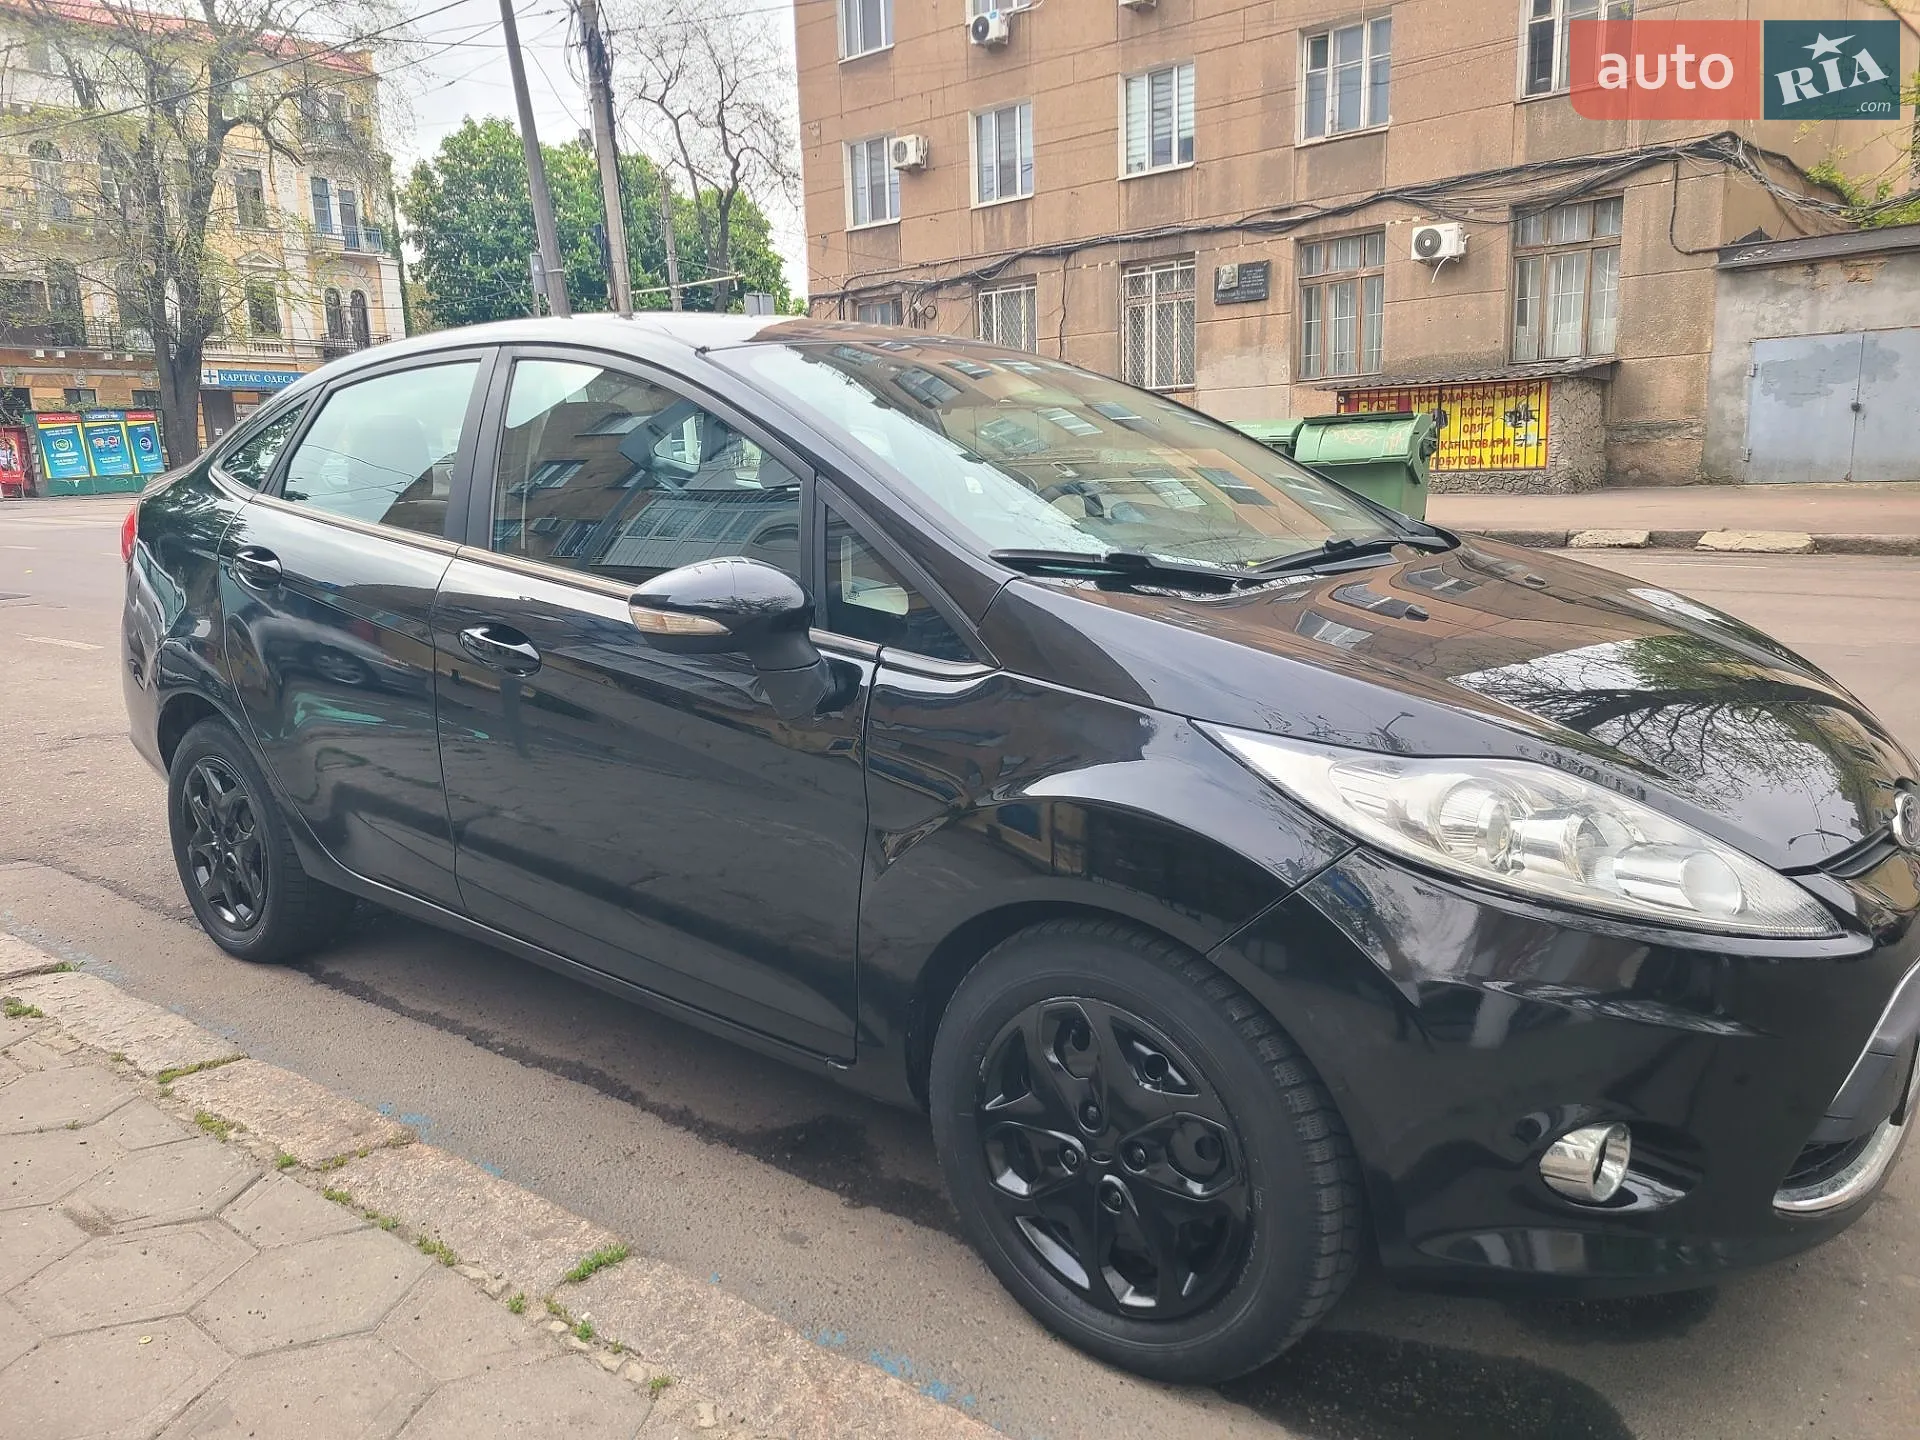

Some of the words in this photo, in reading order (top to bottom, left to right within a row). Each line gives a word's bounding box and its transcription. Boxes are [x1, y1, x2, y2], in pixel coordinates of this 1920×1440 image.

[220, 373, 261, 383] КАРІТАС
[264, 375, 294, 384] ОДЕСА
[1462, 422, 1491, 434] ОДЯГ
[1440, 438, 1511, 451] КАНЦТОВАРИ
[1431, 455, 1485, 467] ПОБУТОВА
[1489, 453, 1520, 465] ХІМІЯ
